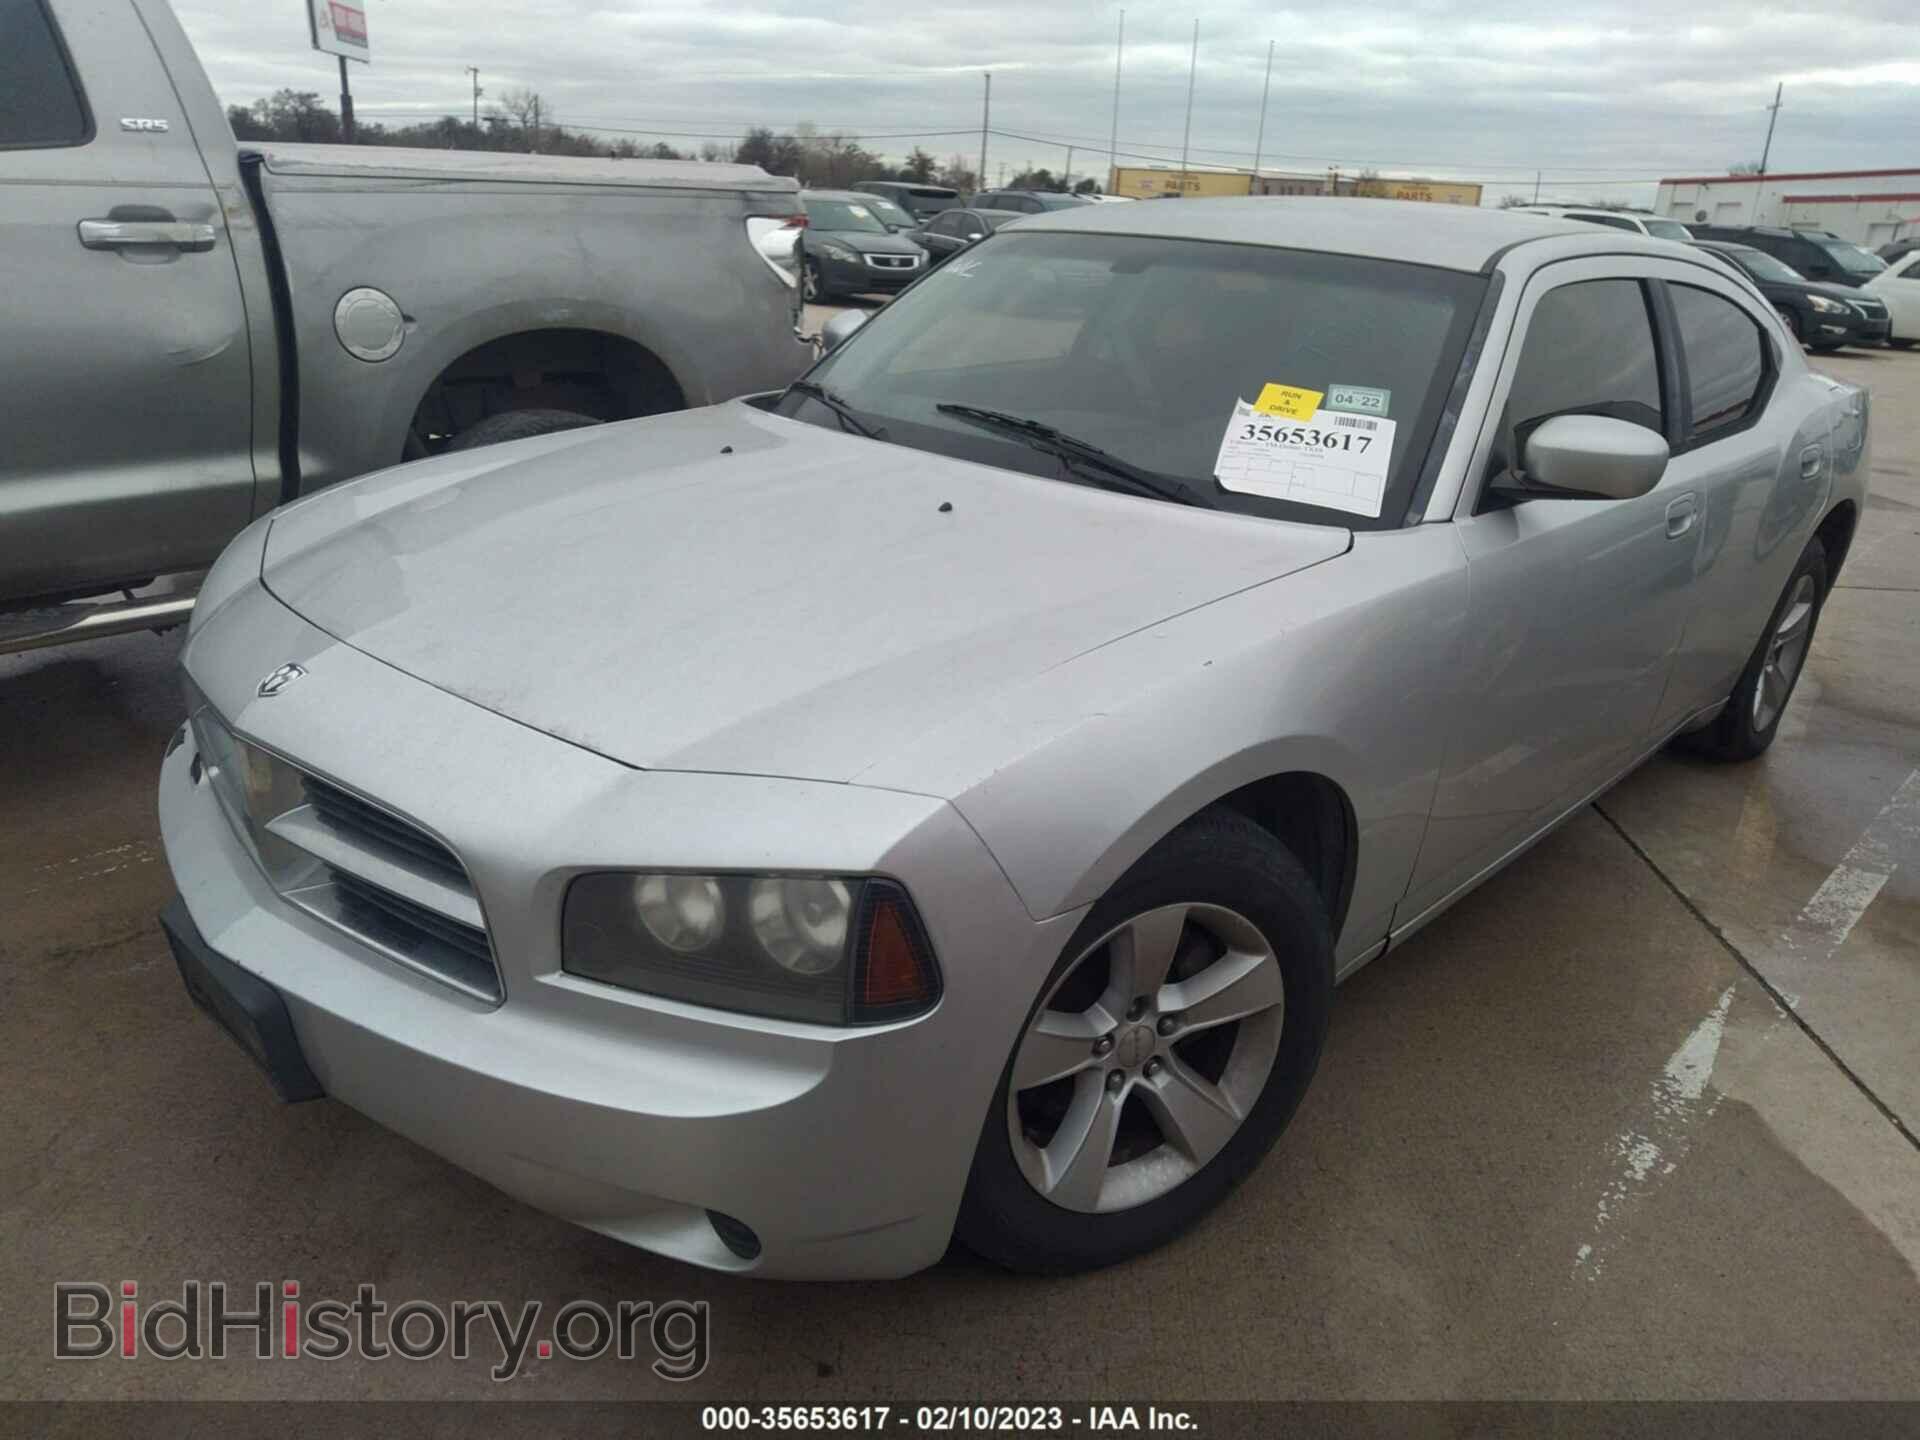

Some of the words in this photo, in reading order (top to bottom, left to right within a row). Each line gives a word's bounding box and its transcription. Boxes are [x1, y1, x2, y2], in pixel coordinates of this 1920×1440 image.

[120, 118, 169, 133] SR5
[1396, 190, 1433, 203] PARTS
[1281, 390, 1303, 400] RUN
[1269, 404, 1299, 416] DRIVE
[1239, 424, 1373, 454] 35653617
